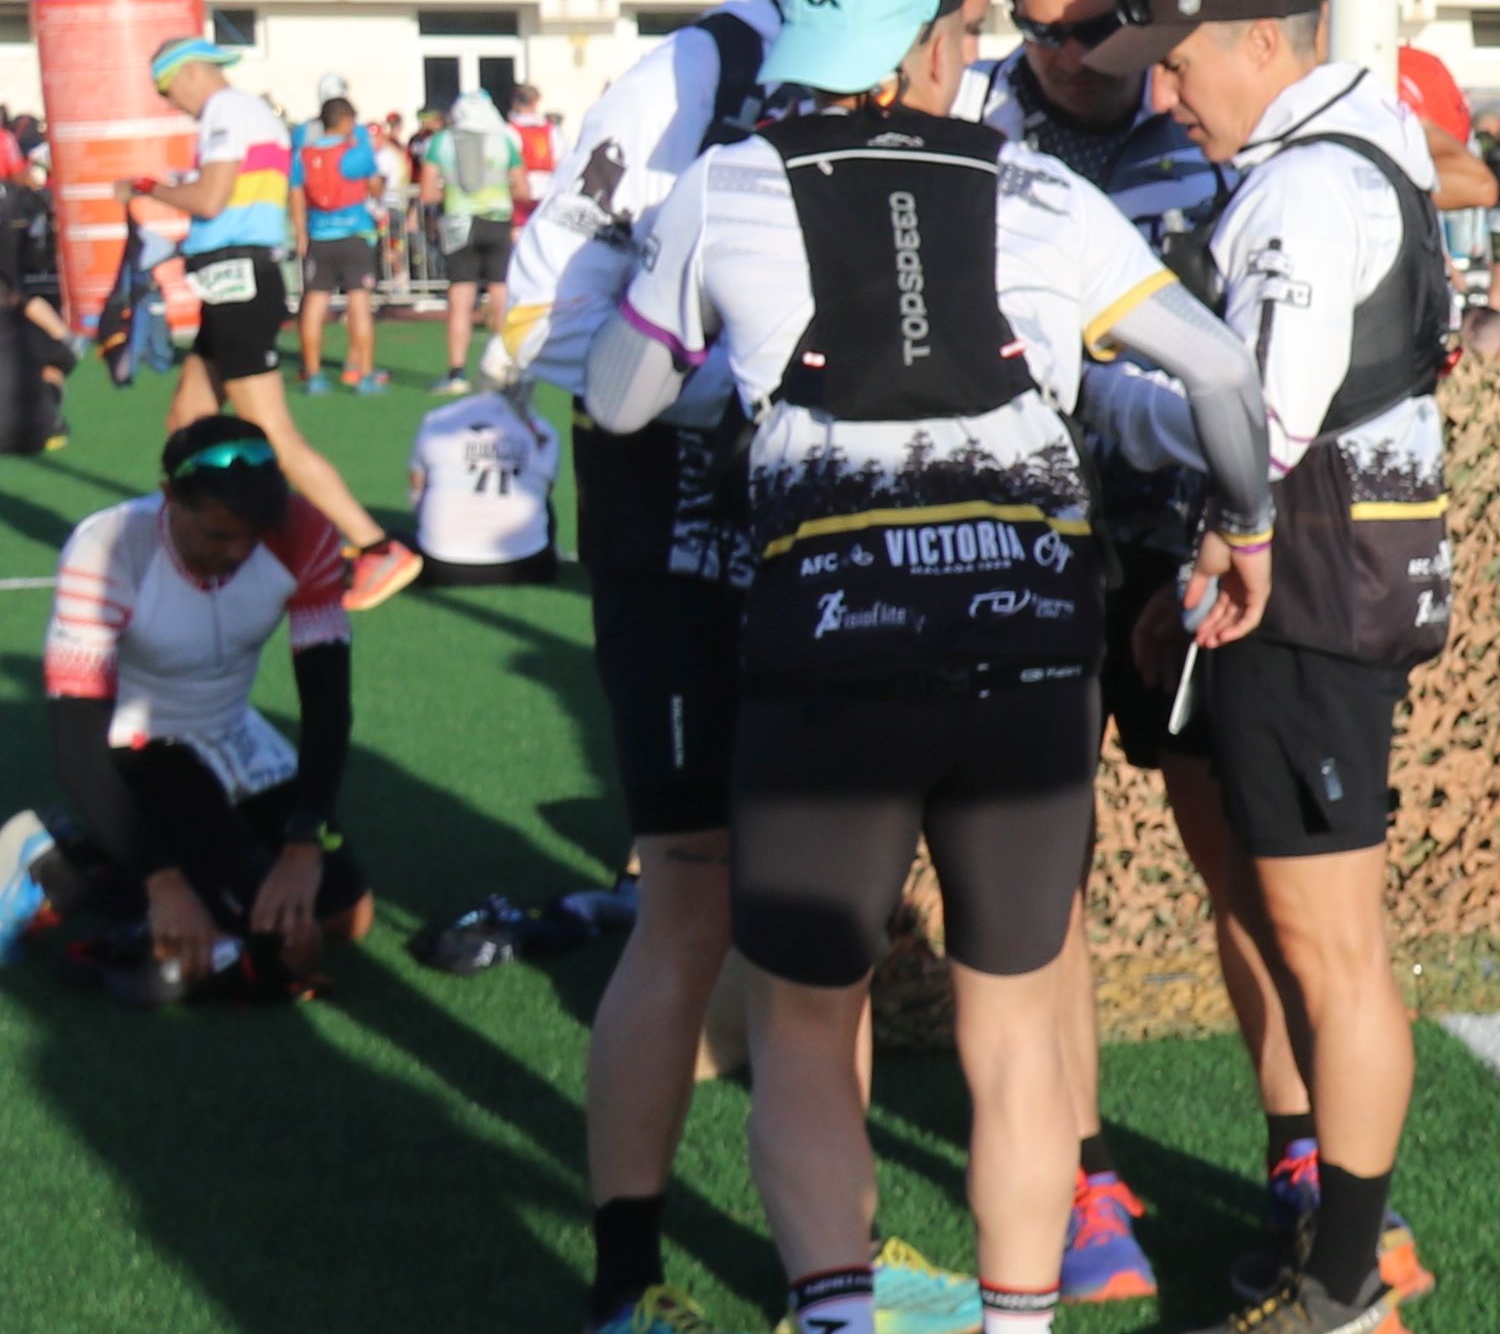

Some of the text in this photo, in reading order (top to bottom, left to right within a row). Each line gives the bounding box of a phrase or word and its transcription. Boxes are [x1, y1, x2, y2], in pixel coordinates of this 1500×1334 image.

[889, 190, 931, 365] TOPSPEED
[801, 553, 838, 578] AFC
[884, 520, 1027, 568] VICTORIA
